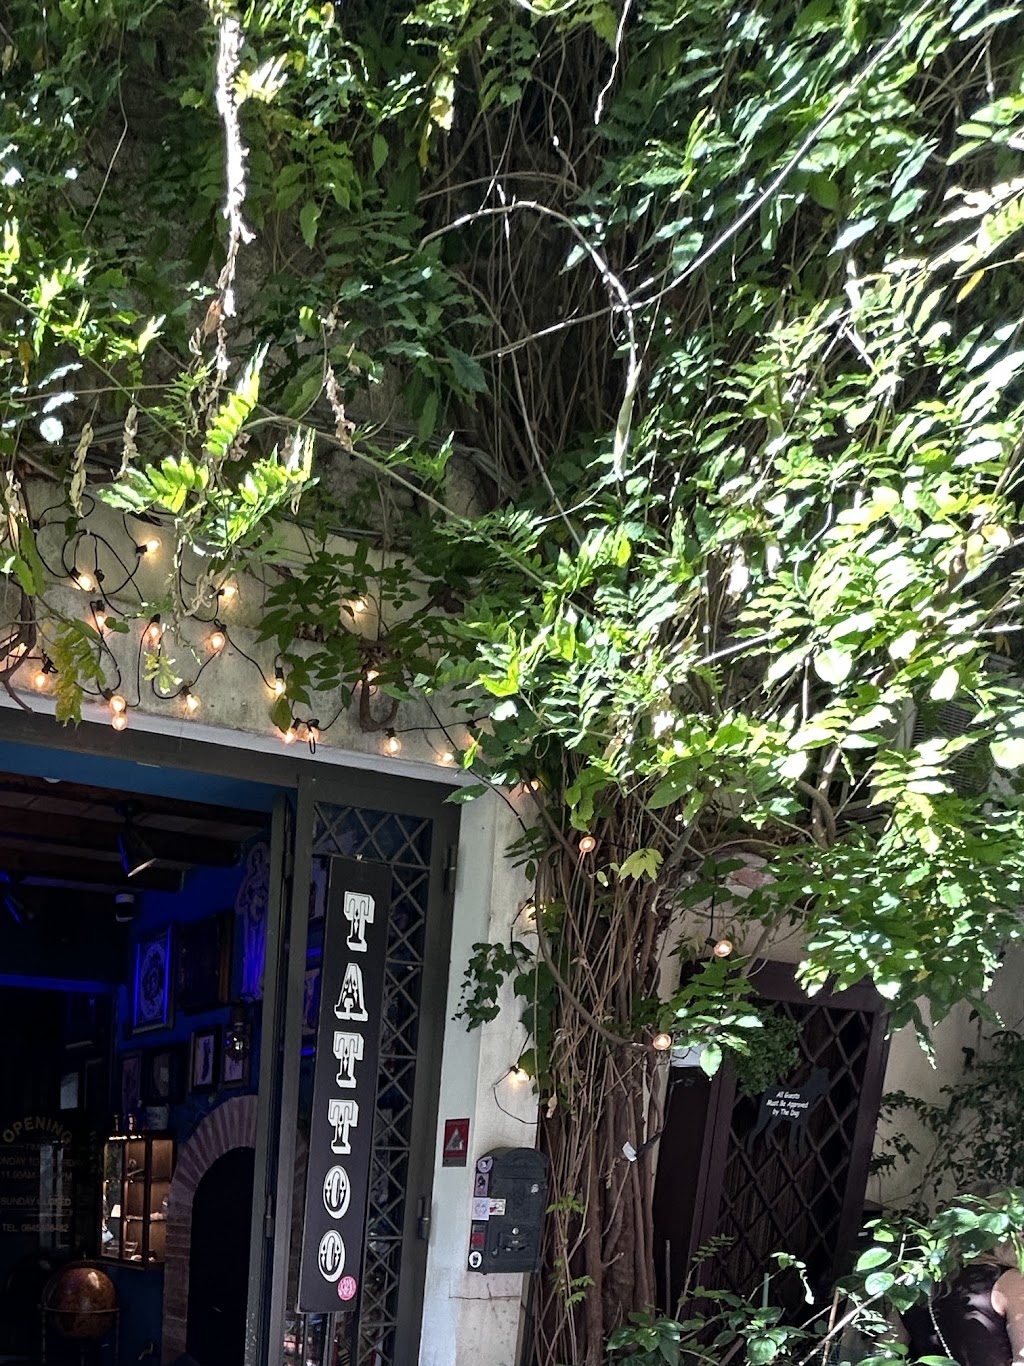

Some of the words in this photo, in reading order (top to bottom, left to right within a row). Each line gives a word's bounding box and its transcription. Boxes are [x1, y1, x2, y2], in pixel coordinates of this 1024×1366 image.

[318, 890, 375, 1283] TATTOO
[787, 1101, 809, 1109] Approved
[2, 1116, 72, 1144] OPENING
[0, 1196, 36, 1206] SUNDAY
